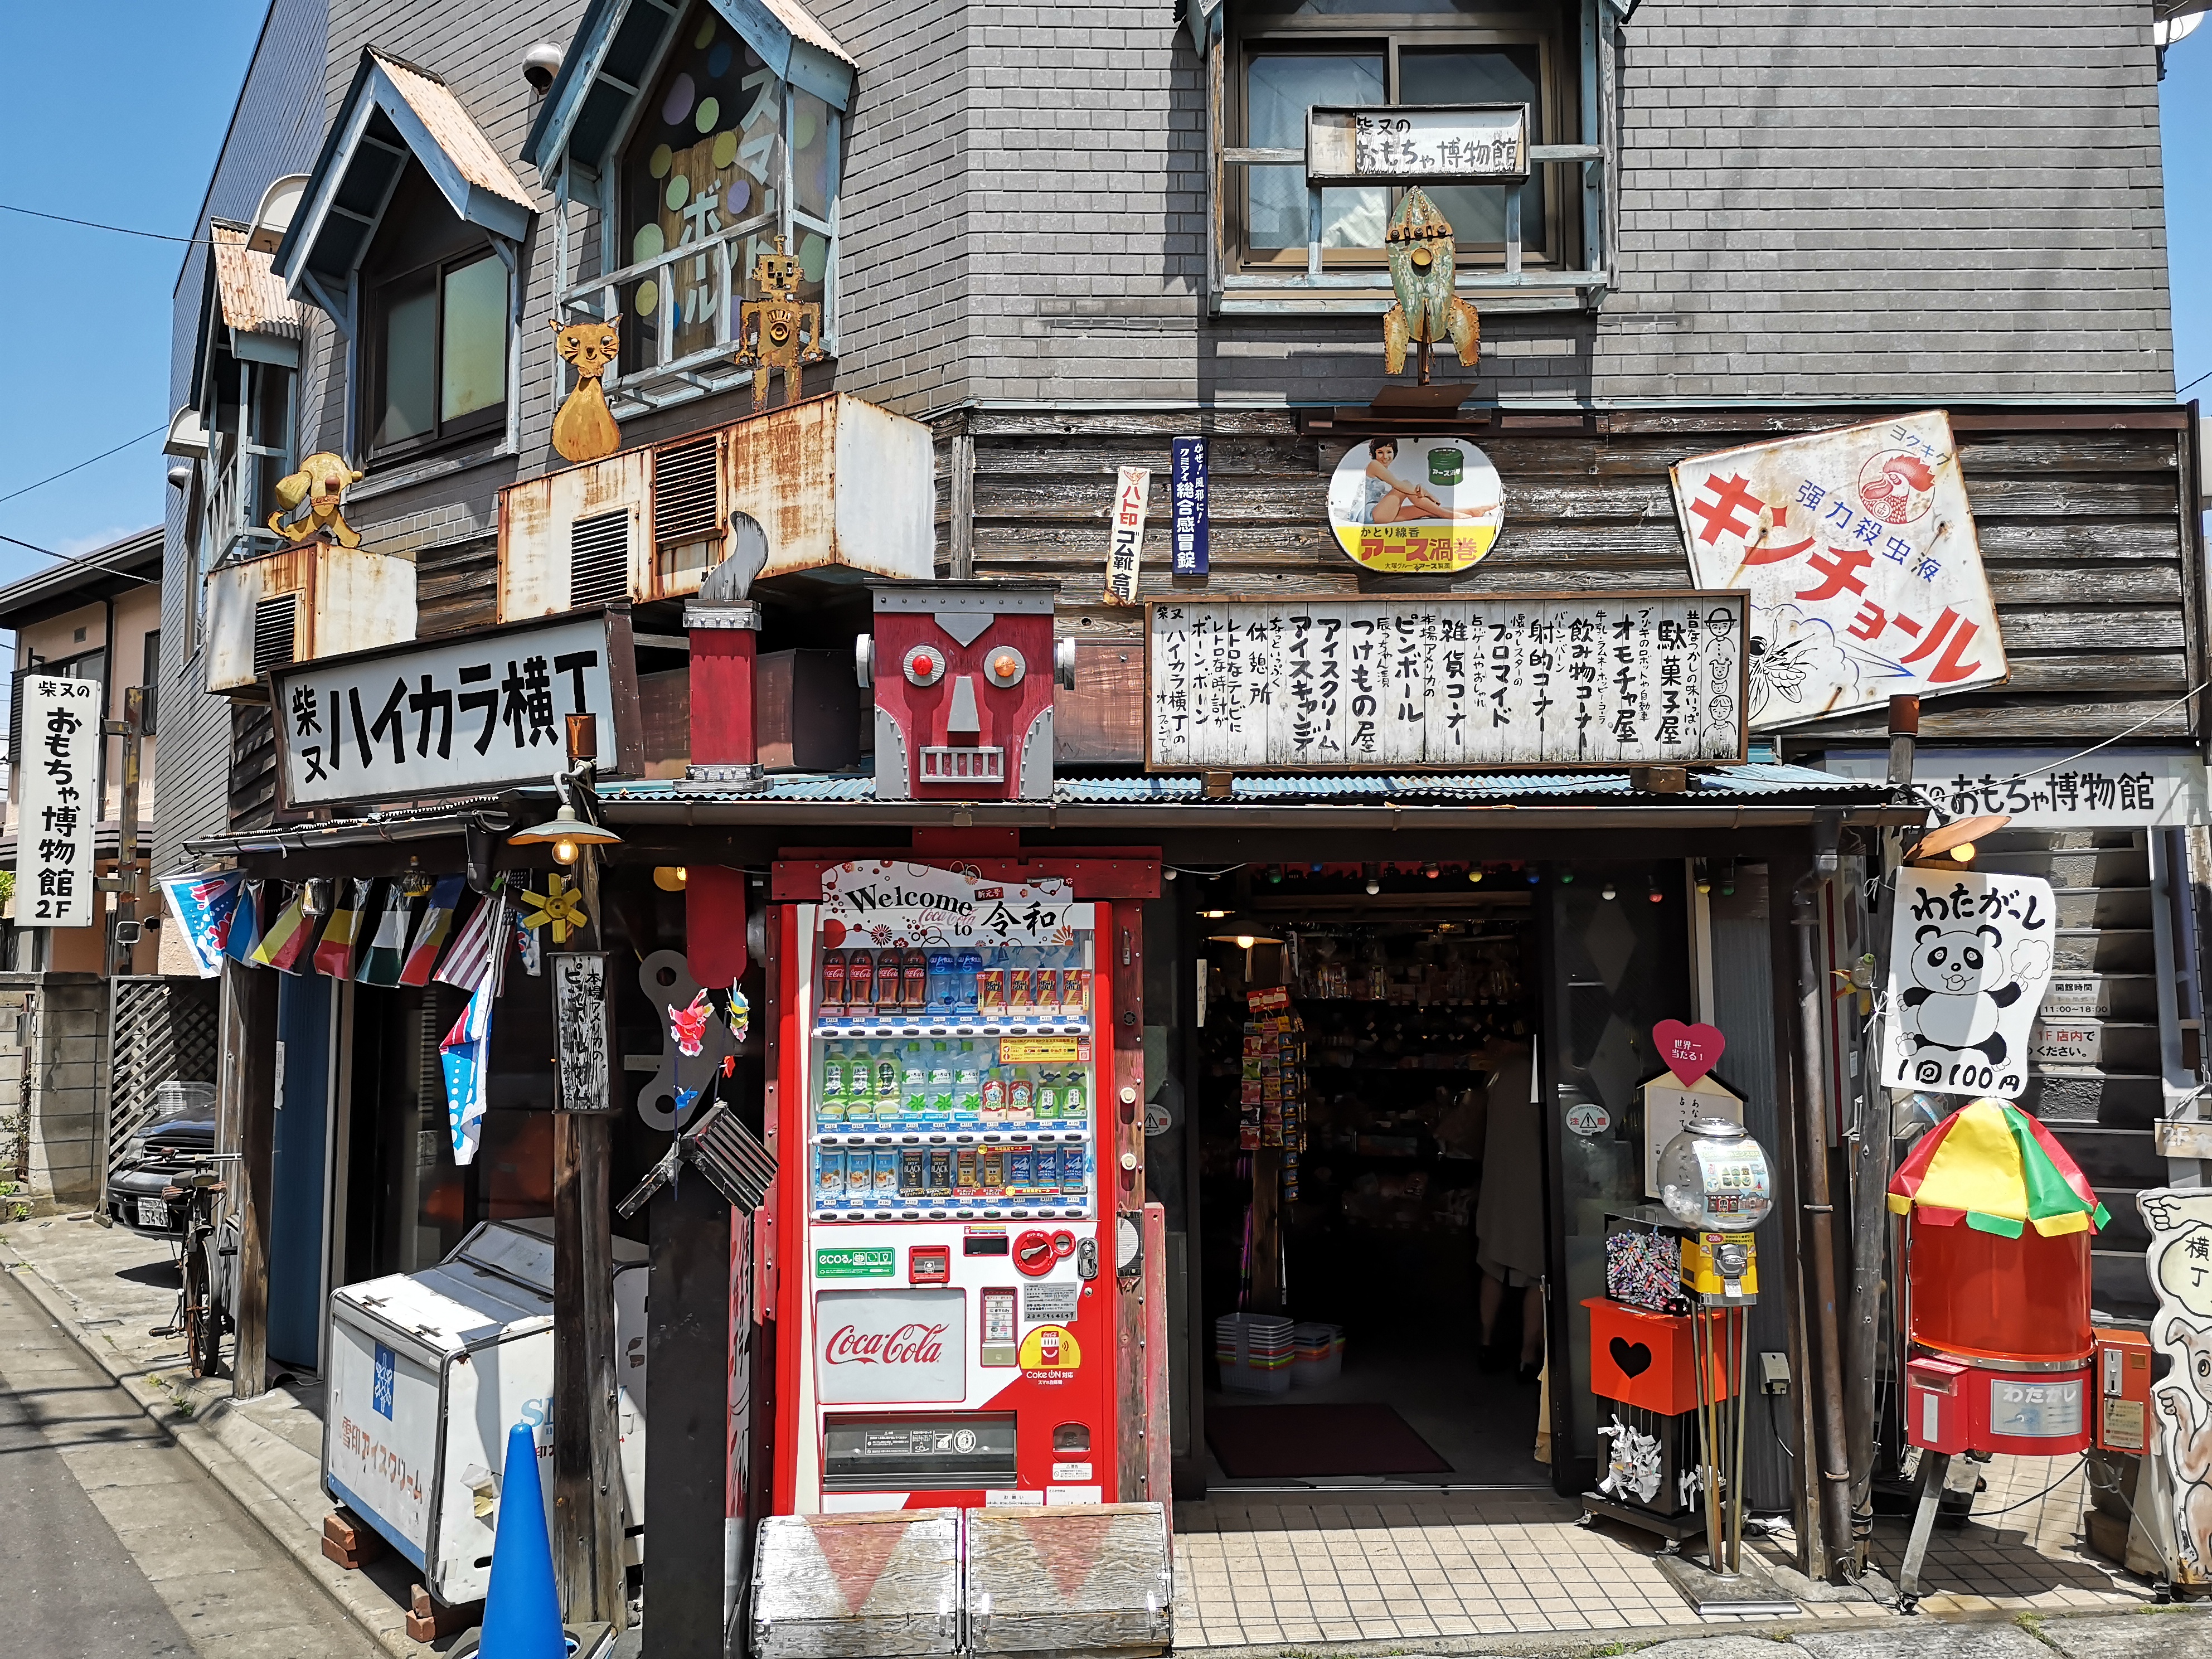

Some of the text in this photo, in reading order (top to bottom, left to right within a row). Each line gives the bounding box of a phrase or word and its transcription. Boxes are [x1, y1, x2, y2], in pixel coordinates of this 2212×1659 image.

[1356, 117, 1411, 135] 柴又の
[1357, 137, 1517, 168] おもちゃ博物館
[1890, 424, 1953, 466] ヨクキク
[1361, 527, 1420, 538] かとり線香
[1361, 538, 1477, 562] アース渦巻
[1157, 606, 1184, 619] 柴又
[1689, 472, 1982, 683] キンチョール
[38, 681, 90, 698] 柴又の
[1167, 629, 1189, 744] ハイカラ横丁の
[1211, 620, 1229, 728] レトロな時計が
[1228, 618, 1243, 733] レトロなテレビに
[1246, 622, 1273, 706] 休憩所
[1269, 617, 1284, 687] ちょっといっぷく
[1317, 618, 1341, 752] アイスクリーム
[1350, 620, 1377, 753] つけもの屋
[1395, 613, 1424, 722] ピンボール
[1420, 614, 1436, 698] 本場アメリカの
[1439, 619, 1468, 745] 雑貨コーナー
[1472, 614, 1487, 707] 占いゲームやおしゃれ
[1488, 623, 1512, 727] プロマイド
[1528, 618, 1554, 731] 射的コーナー
[1568, 618, 1596, 748] 飲み物コーナー
[1612, 614, 1638, 743] オモチャ屋
[1638, 607, 1654, 722] ブリキのロボットや自動車
[1654, 619, 1687, 745] 駄菓子屋
[1684, 610, 1700, 736] 昔なつかしの味いっぱい
[292, 684, 327, 784] 柴又
[329, 650, 598, 770] ハイカラ横丁
[37, 707, 83, 896] おもちゃ博物館
[35, 900, 72, 919] 2F
[845, 884, 973, 917] Welcome
[954, 900, 1056, 937] to 令和
[978, 888, 1001, 899] 新元号
[1910, 883, 2045, 930] わたがし
[1675, 1039, 1701, 1050] 世界一
[1898, 1059, 2020, 1092] 1回100円
[2029, 1031, 2095, 1041] 1F店内で
[2163, 1127, 2190, 1146] 2F
[826, 1323, 950, 1365] Coca-Cola
[2003, 1386, 2077, 1404] わたがし
[342, 1416, 423, 1505] 雪印アイスクリーム
